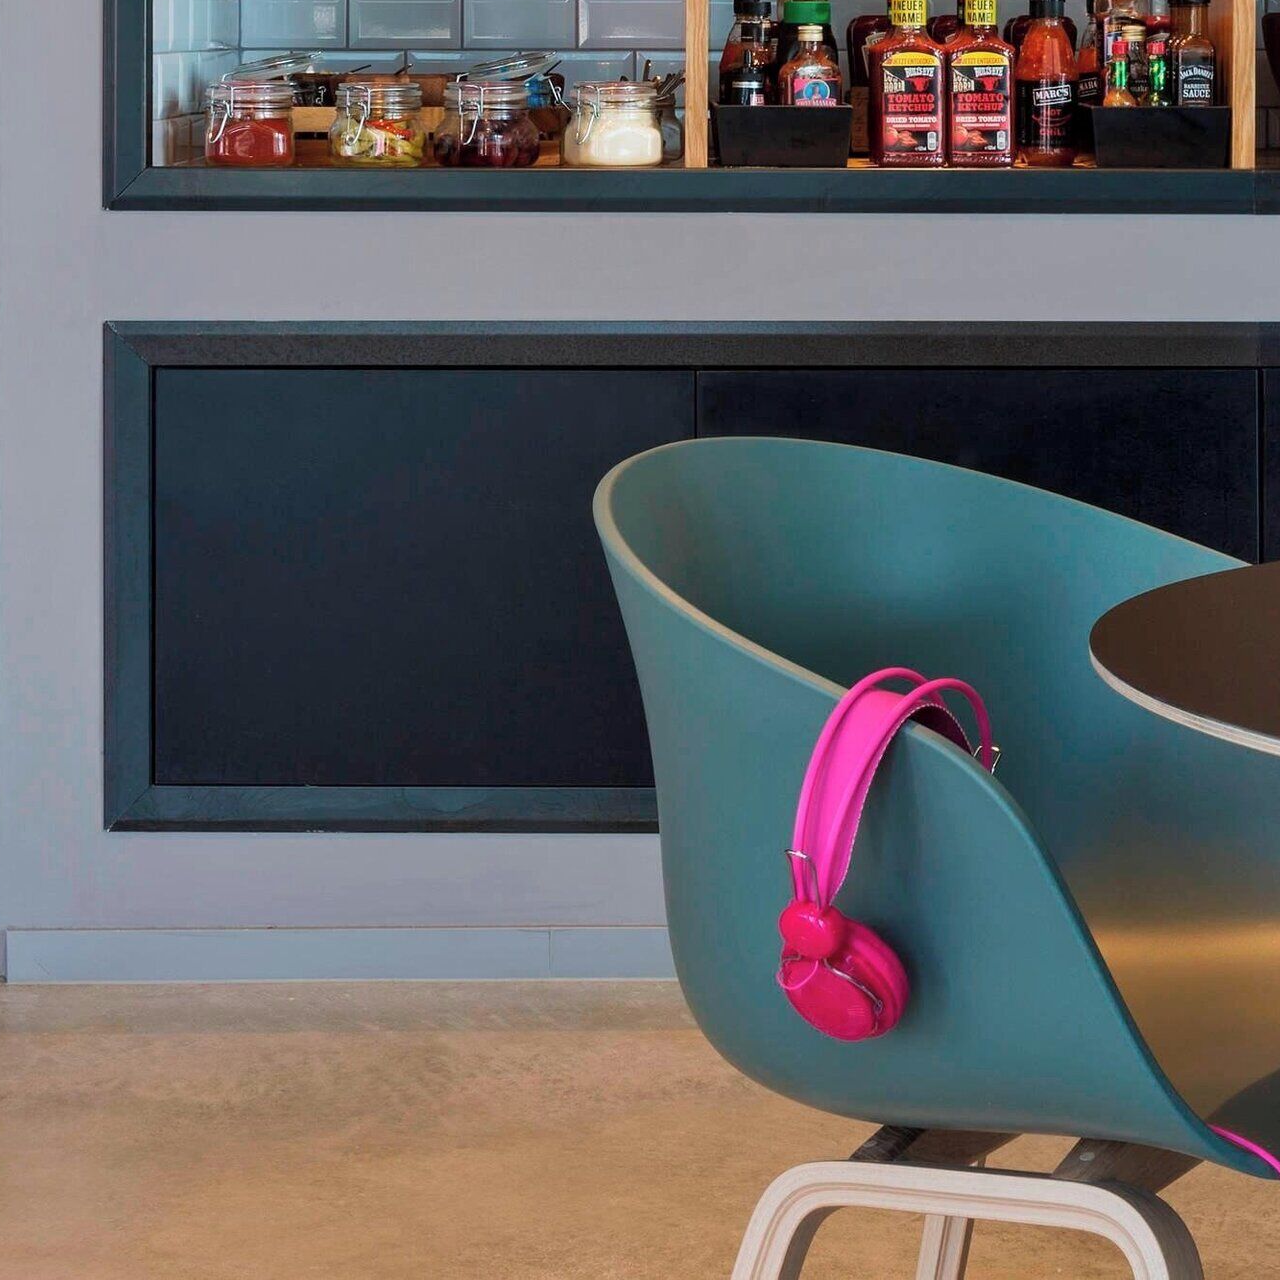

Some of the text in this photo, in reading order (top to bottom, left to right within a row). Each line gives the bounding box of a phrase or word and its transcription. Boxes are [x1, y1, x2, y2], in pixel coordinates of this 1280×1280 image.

[967, 0, 994, 10] NEUER
[967, 12, 994, 22] NAME!
[1180, 69, 1192, 79] JACK
[888, 94, 934, 103] TOMATO
[958, 93, 1004, 102] TOMATO
[1035, 88, 1069, 100] MARC'S
[1183, 90, 1210, 98] SAUCE
[888, 104, 934, 112] KETCHUP
[958, 103, 1004, 111] KETCHUP
